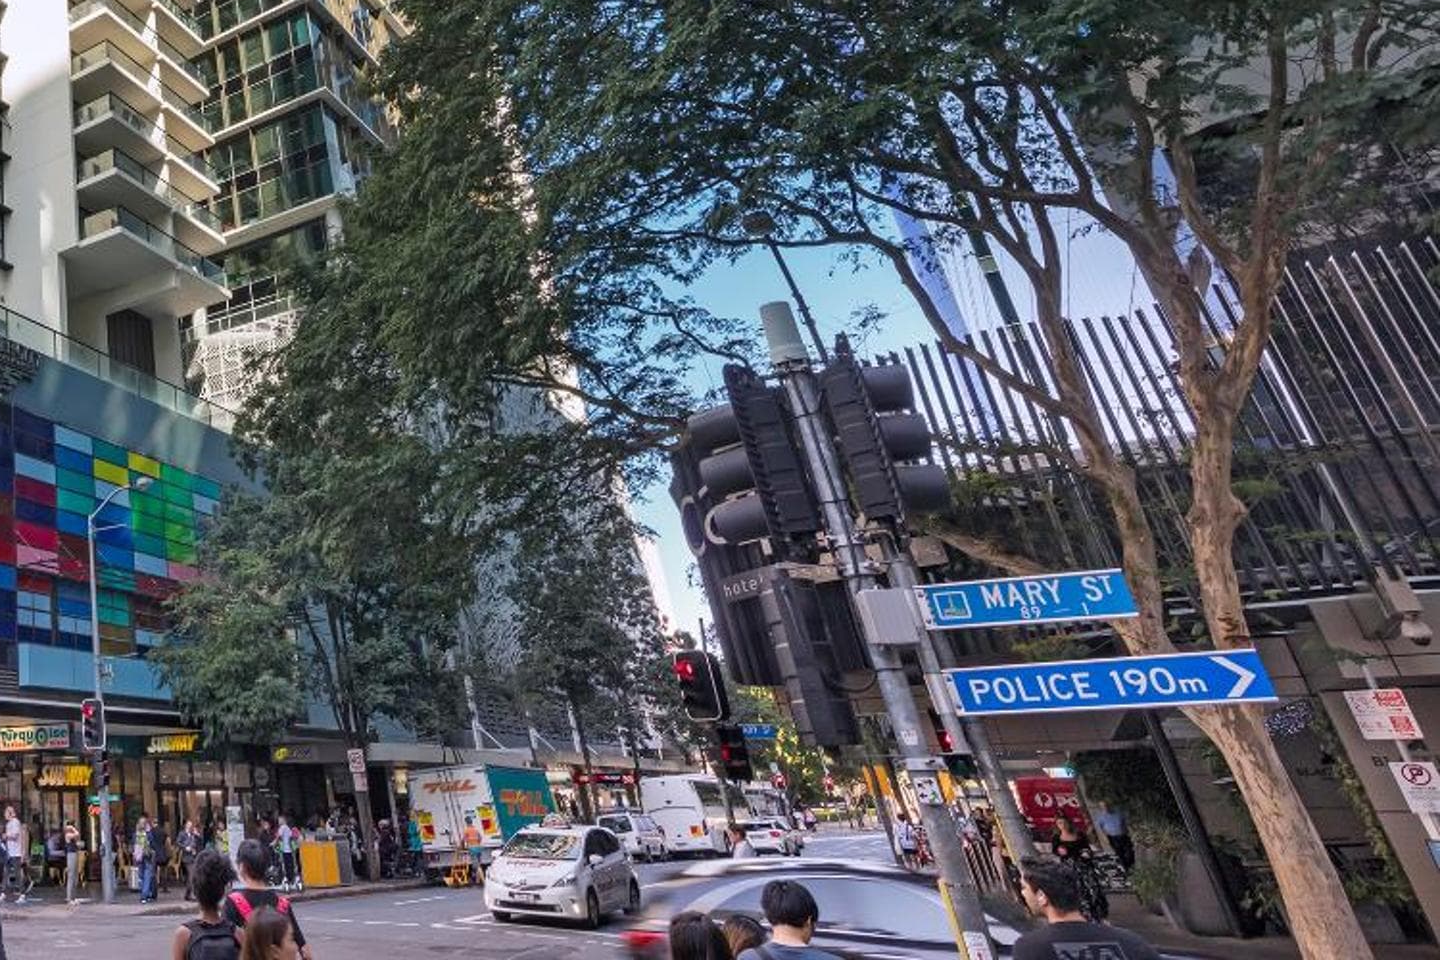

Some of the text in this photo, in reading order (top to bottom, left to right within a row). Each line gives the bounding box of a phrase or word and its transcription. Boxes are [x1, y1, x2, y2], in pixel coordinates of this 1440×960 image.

[723, 575, 764, 598] hotel
[981, 574, 1112, 609] MARY ST
[1020, 605, 1041, 620] 89
[969, 671, 1100, 705] POLICE
[147, 734, 199, 754] SUBWAY
[36, 763, 93, 787] SUBWAY
